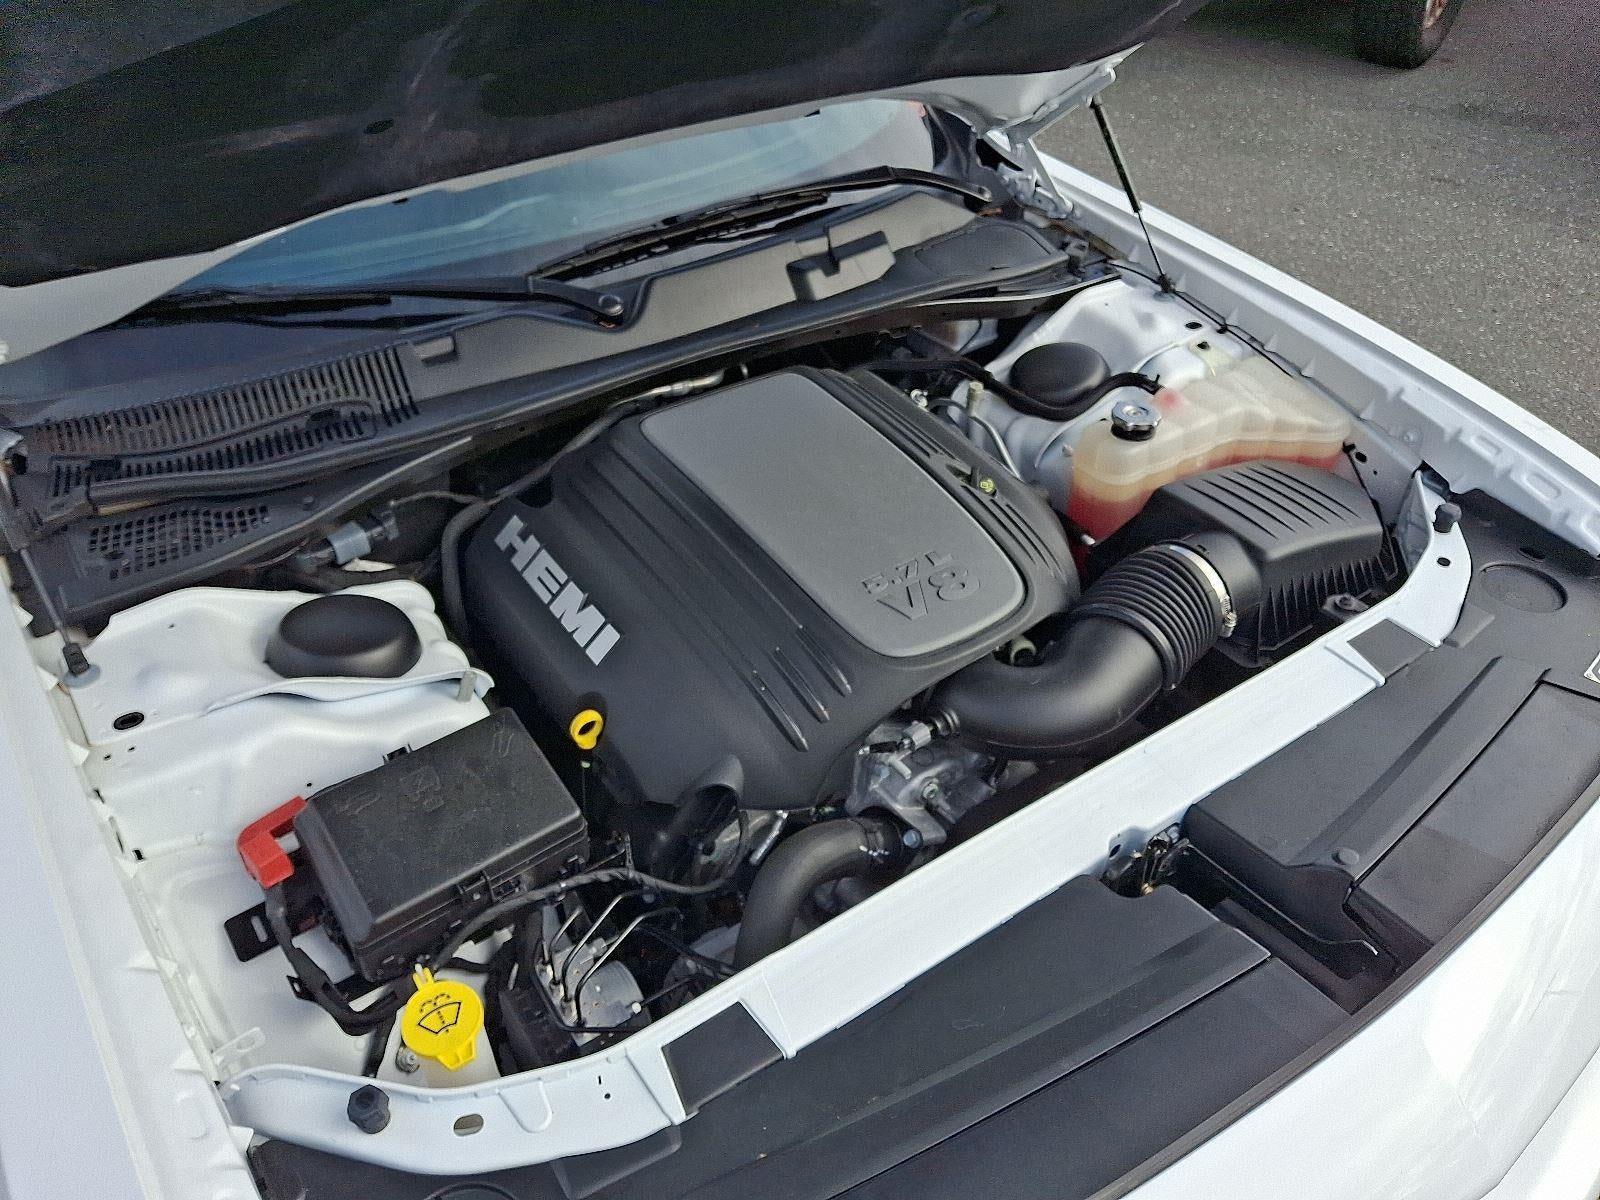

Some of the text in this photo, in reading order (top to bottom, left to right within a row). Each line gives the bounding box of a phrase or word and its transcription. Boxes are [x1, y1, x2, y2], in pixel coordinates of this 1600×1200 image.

[494, 514, 620, 666] HEMI
[861, 550, 955, 597] 5.7L
[875, 568, 981, 621] V8
